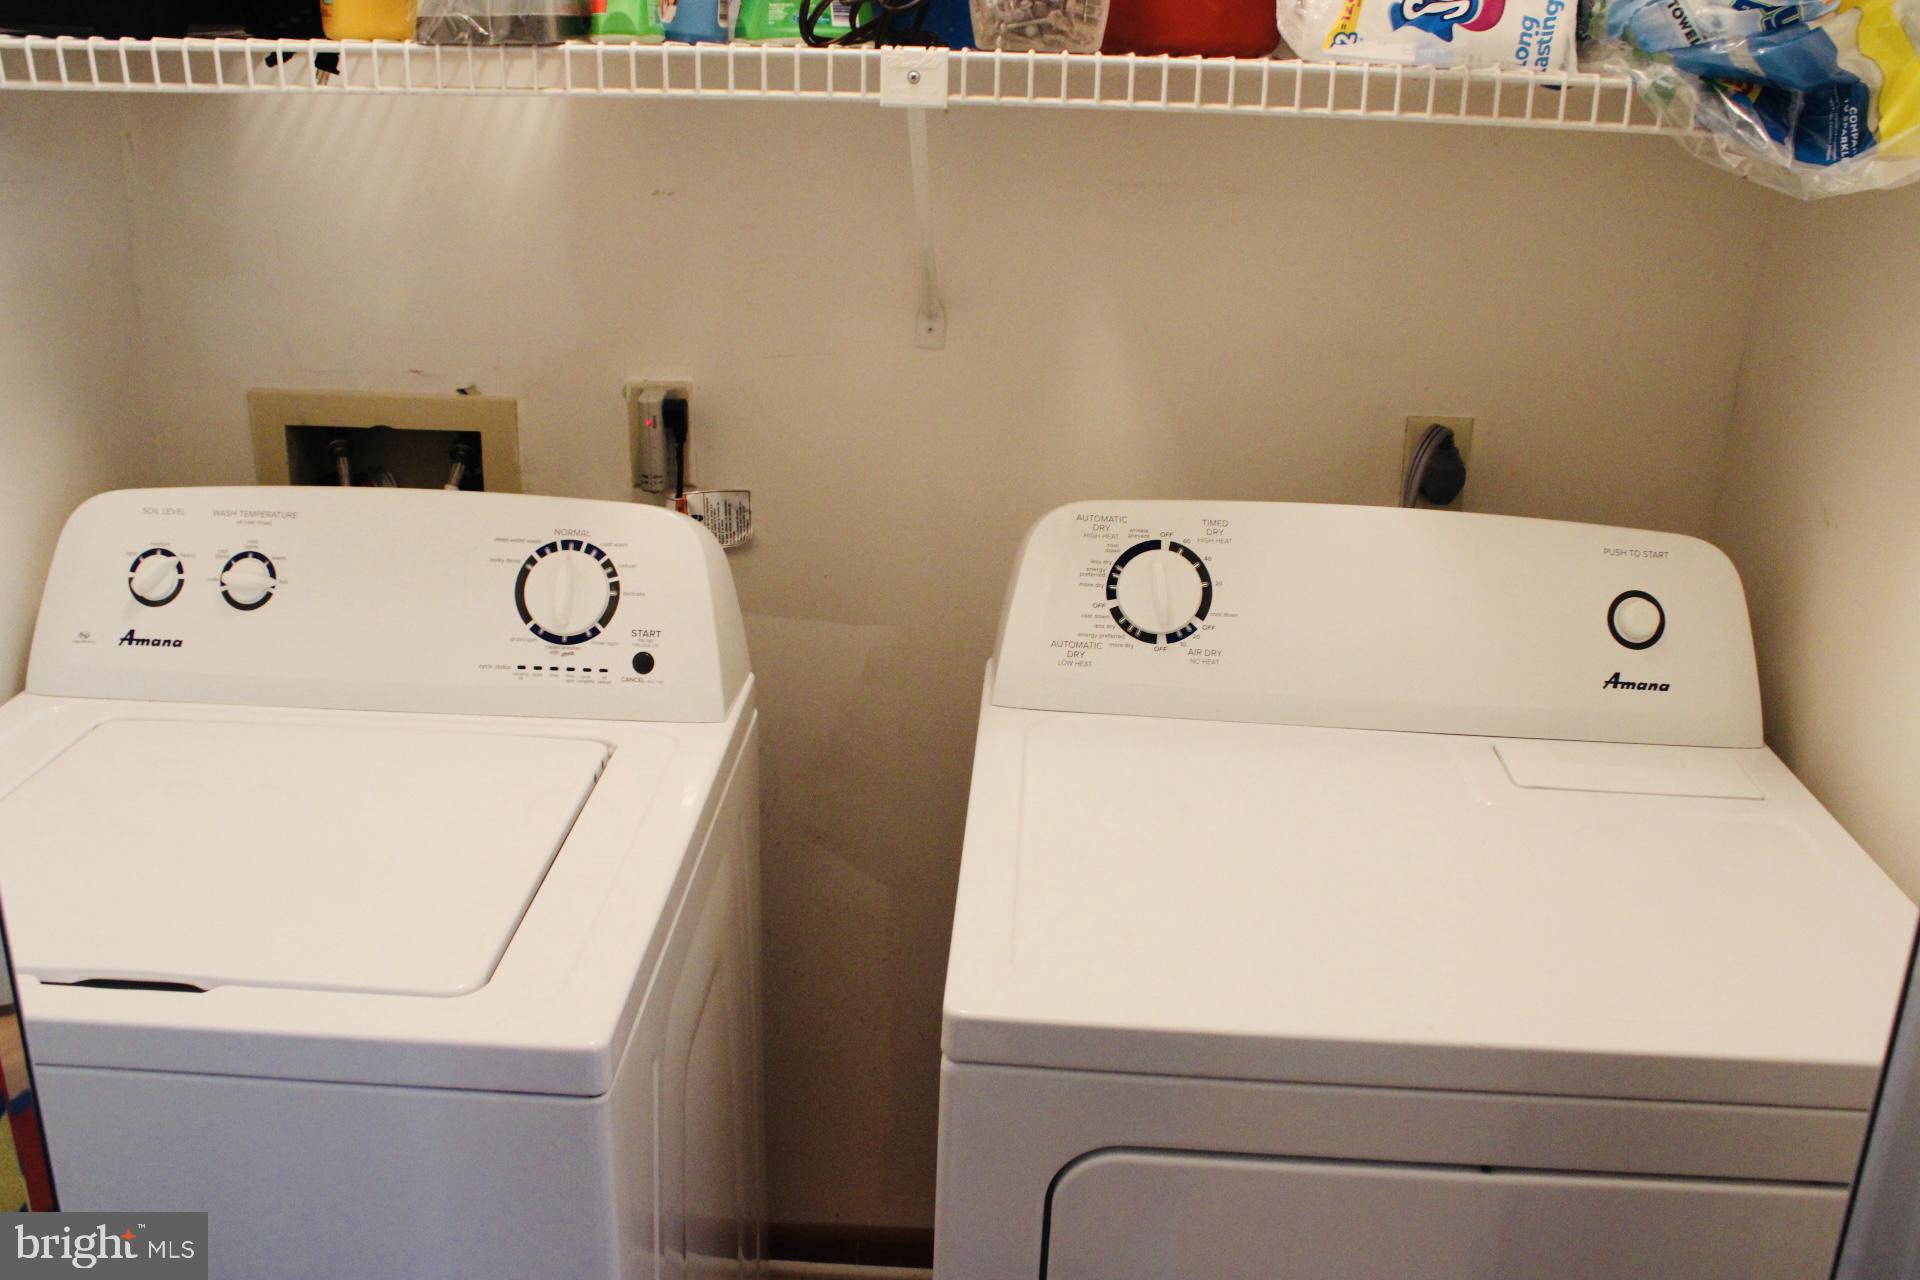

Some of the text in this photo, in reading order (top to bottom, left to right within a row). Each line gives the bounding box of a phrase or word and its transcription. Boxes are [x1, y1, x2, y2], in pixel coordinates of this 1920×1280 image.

[162, 508, 185, 516] LEVEL
[240, 510, 298, 519] TEMPERATURE
[1076, 513, 1128, 524] AUTOMATIC
[1092, 524, 1111, 532] DRY
[1202, 519, 1229, 528] TIMED
[553, 528, 590, 537] NORMAL
[1206, 528, 1224, 536] DRY
[1602, 548, 1670, 559] PUSH TO START
[118, 628, 184, 648] Amana
[631, 629, 662, 638] START
[1050, 640, 1104, 650] AUTOMATIC
[1066, 650, 1086, 658] DRY
[1188, 648, 1222, 657] AIR DRY
[1602, 672, 1670, 692] Amana
